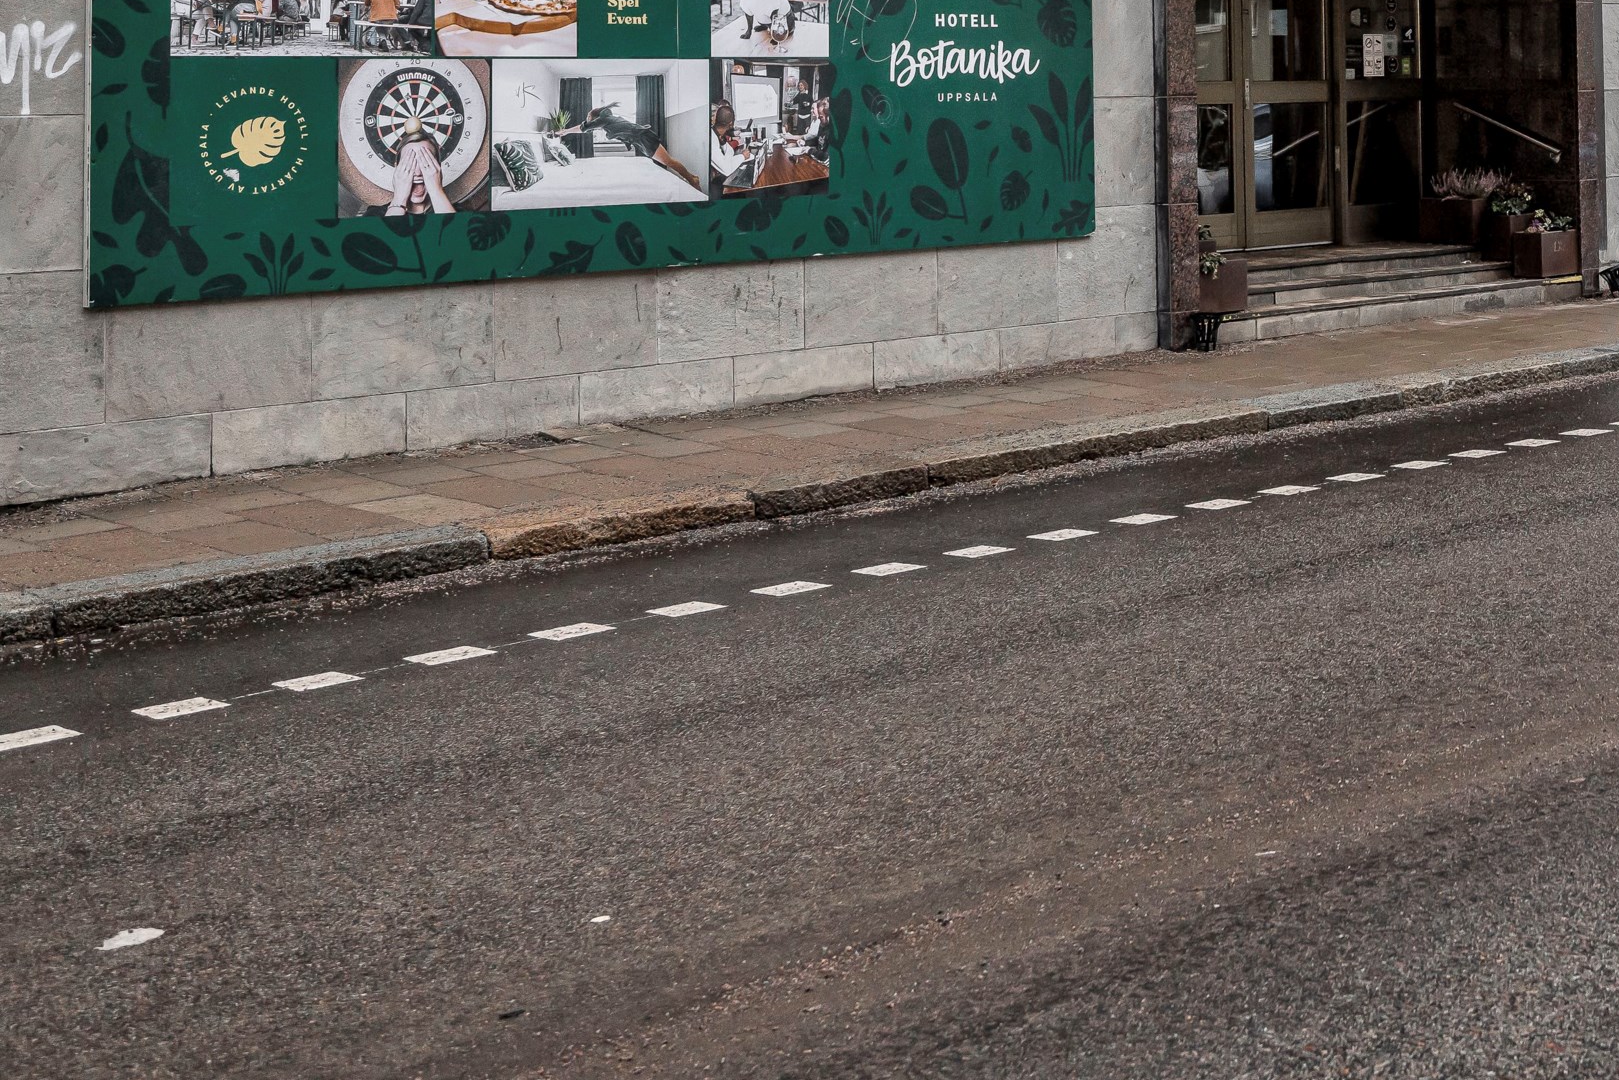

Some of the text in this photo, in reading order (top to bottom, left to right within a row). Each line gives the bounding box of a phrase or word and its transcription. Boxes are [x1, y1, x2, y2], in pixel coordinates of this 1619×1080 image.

[607, 12, 648, 25] Event
[935, 13, 999, 28] HOTELL
[889, 40, 1040, 88] Botanika
[396, 72, 434, 82] WINMAU
[215, 86, 275, 109] LEVANDE
[937, 92, 998, 102] UPPSALA
[280, 95, 309, 139] HOTELL
[199, 124, 224, 183] UPPSALA
[252, 158, 304, 195] HJÄRTAT
[227, 182, 245, 193] AV
